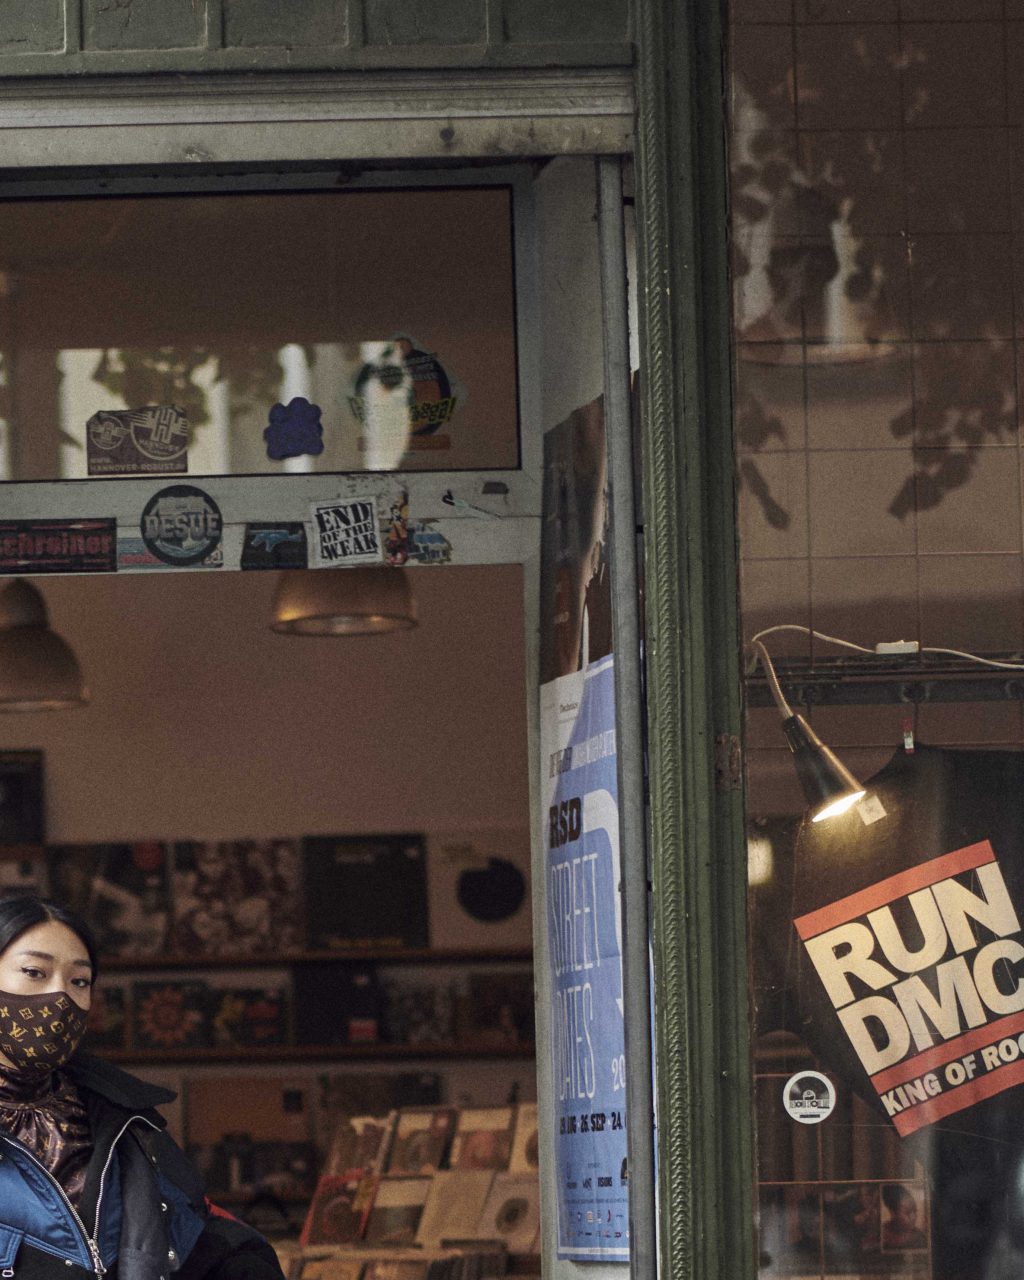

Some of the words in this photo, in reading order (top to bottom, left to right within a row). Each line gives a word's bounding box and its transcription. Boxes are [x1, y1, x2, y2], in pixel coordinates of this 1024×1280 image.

[144, 513, 220, 540] DESUE
[315, 503, 370, 533] END
[322, 531, 340, 543] OF
[342, 521, 372, 539] THE
[323, 532, 378, 560] WEAK
[549, 797, 581, 848] RSD
[551, 853, 600, 977] STREET
[804, 861, 1021, 1010] RUN
[836, 939, 1024, 1077] DMC
[880, 1073, 942, 1116] KING
[945, 1055, 976, 1086] OF
